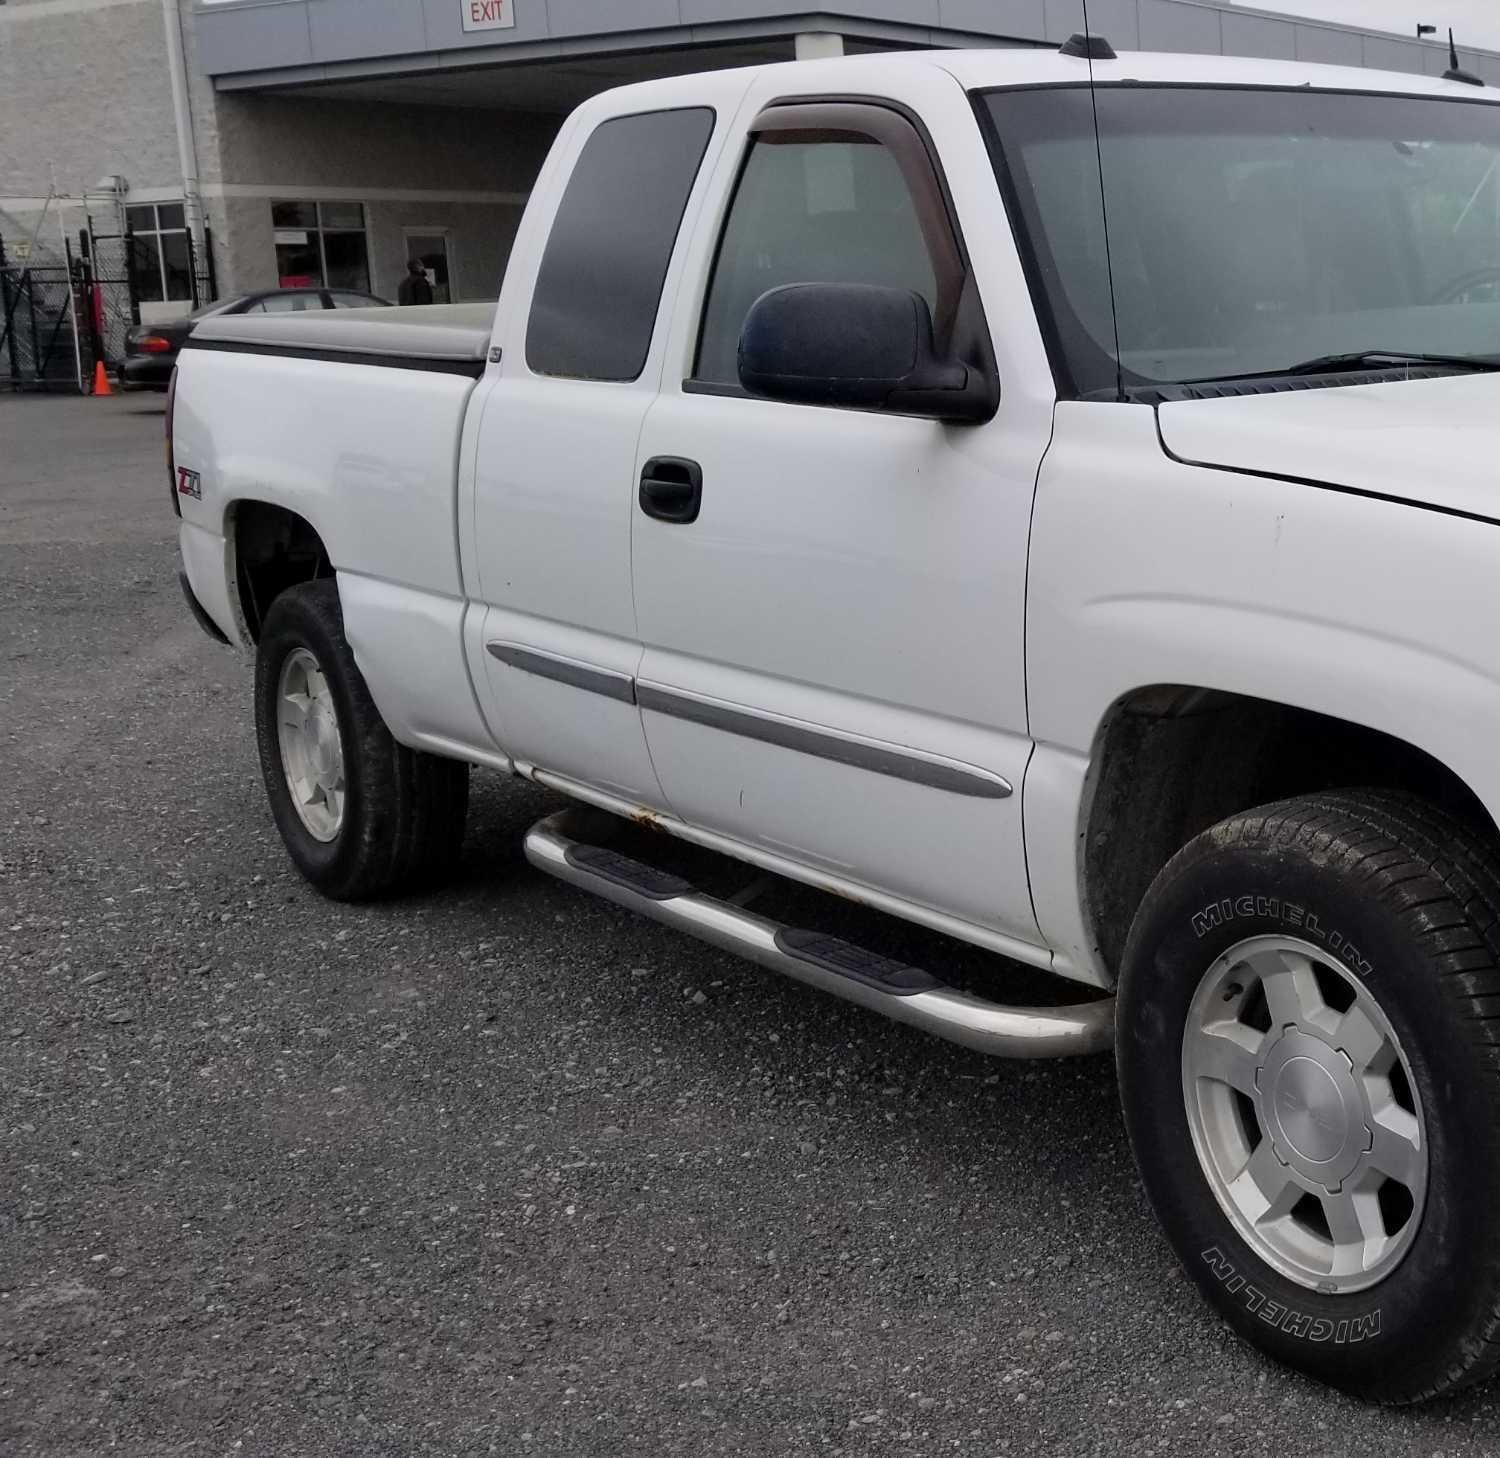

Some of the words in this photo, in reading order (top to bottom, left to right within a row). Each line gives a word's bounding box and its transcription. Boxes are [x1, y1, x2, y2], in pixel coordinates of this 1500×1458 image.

[471, 0, 502, 23] EXIT
[1191, 895, 1374, 977] MICHELIN
[1200, 1247, 1382, 1345] MICHELIN
